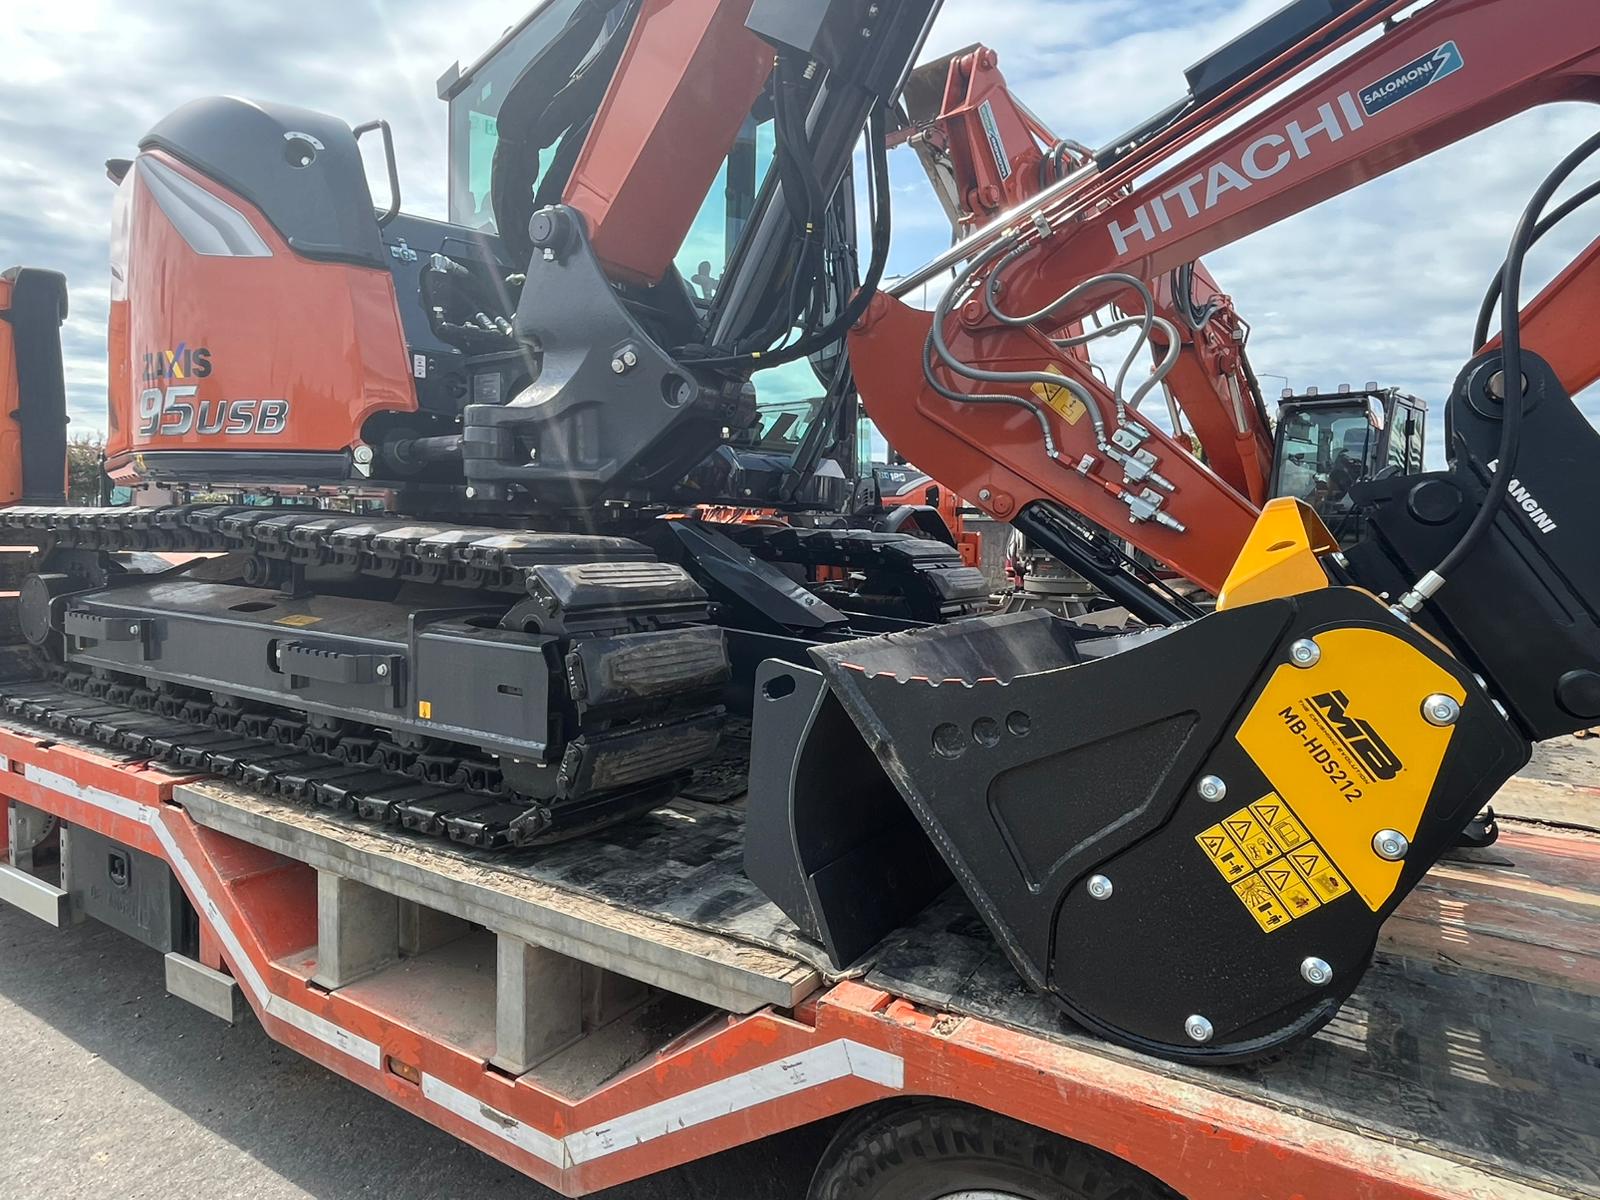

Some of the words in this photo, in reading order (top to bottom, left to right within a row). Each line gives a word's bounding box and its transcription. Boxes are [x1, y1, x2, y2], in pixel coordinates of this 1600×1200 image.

[1363, 60, 1436, 106] SALOMONI
[1107, 90, 1365, 257] HITACHI
[1277, 705, 1364, 804] MB-HDS212
[1311, 689, 1404, 781] MB
